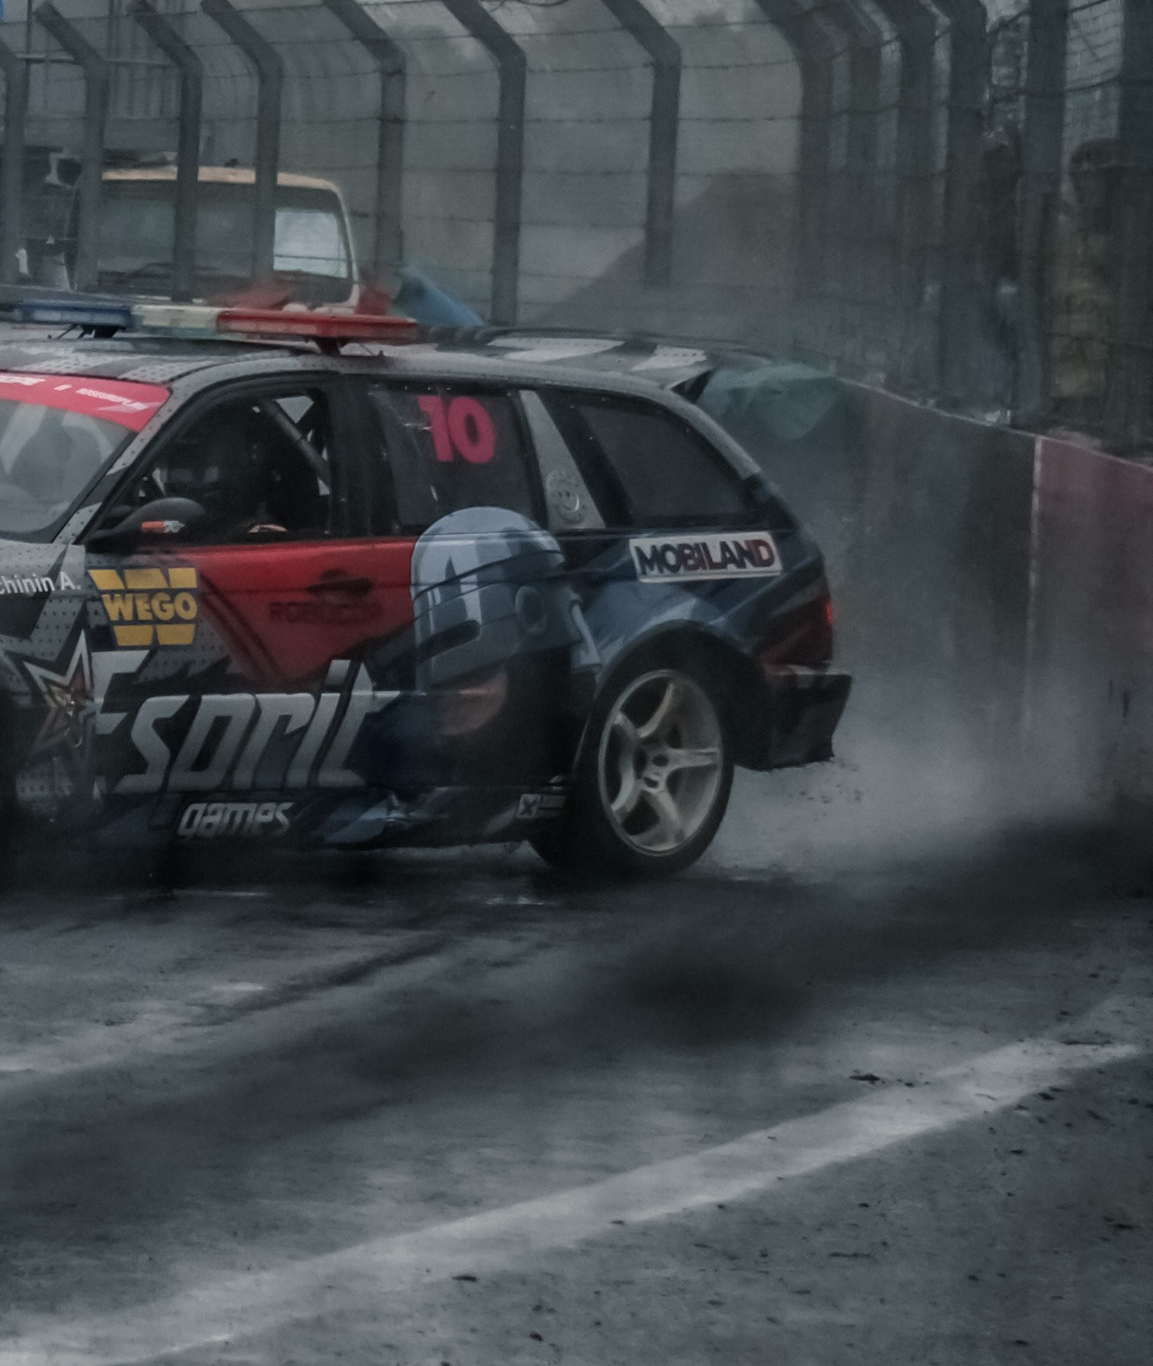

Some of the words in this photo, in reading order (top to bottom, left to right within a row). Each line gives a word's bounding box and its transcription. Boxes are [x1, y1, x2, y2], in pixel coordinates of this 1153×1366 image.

[417, 395, 496, 464] 10
[633, 539, 776, 575] MOBILAND
[60, 571, 82, 591] A.
[101, 591, 198, 621] WEGO
